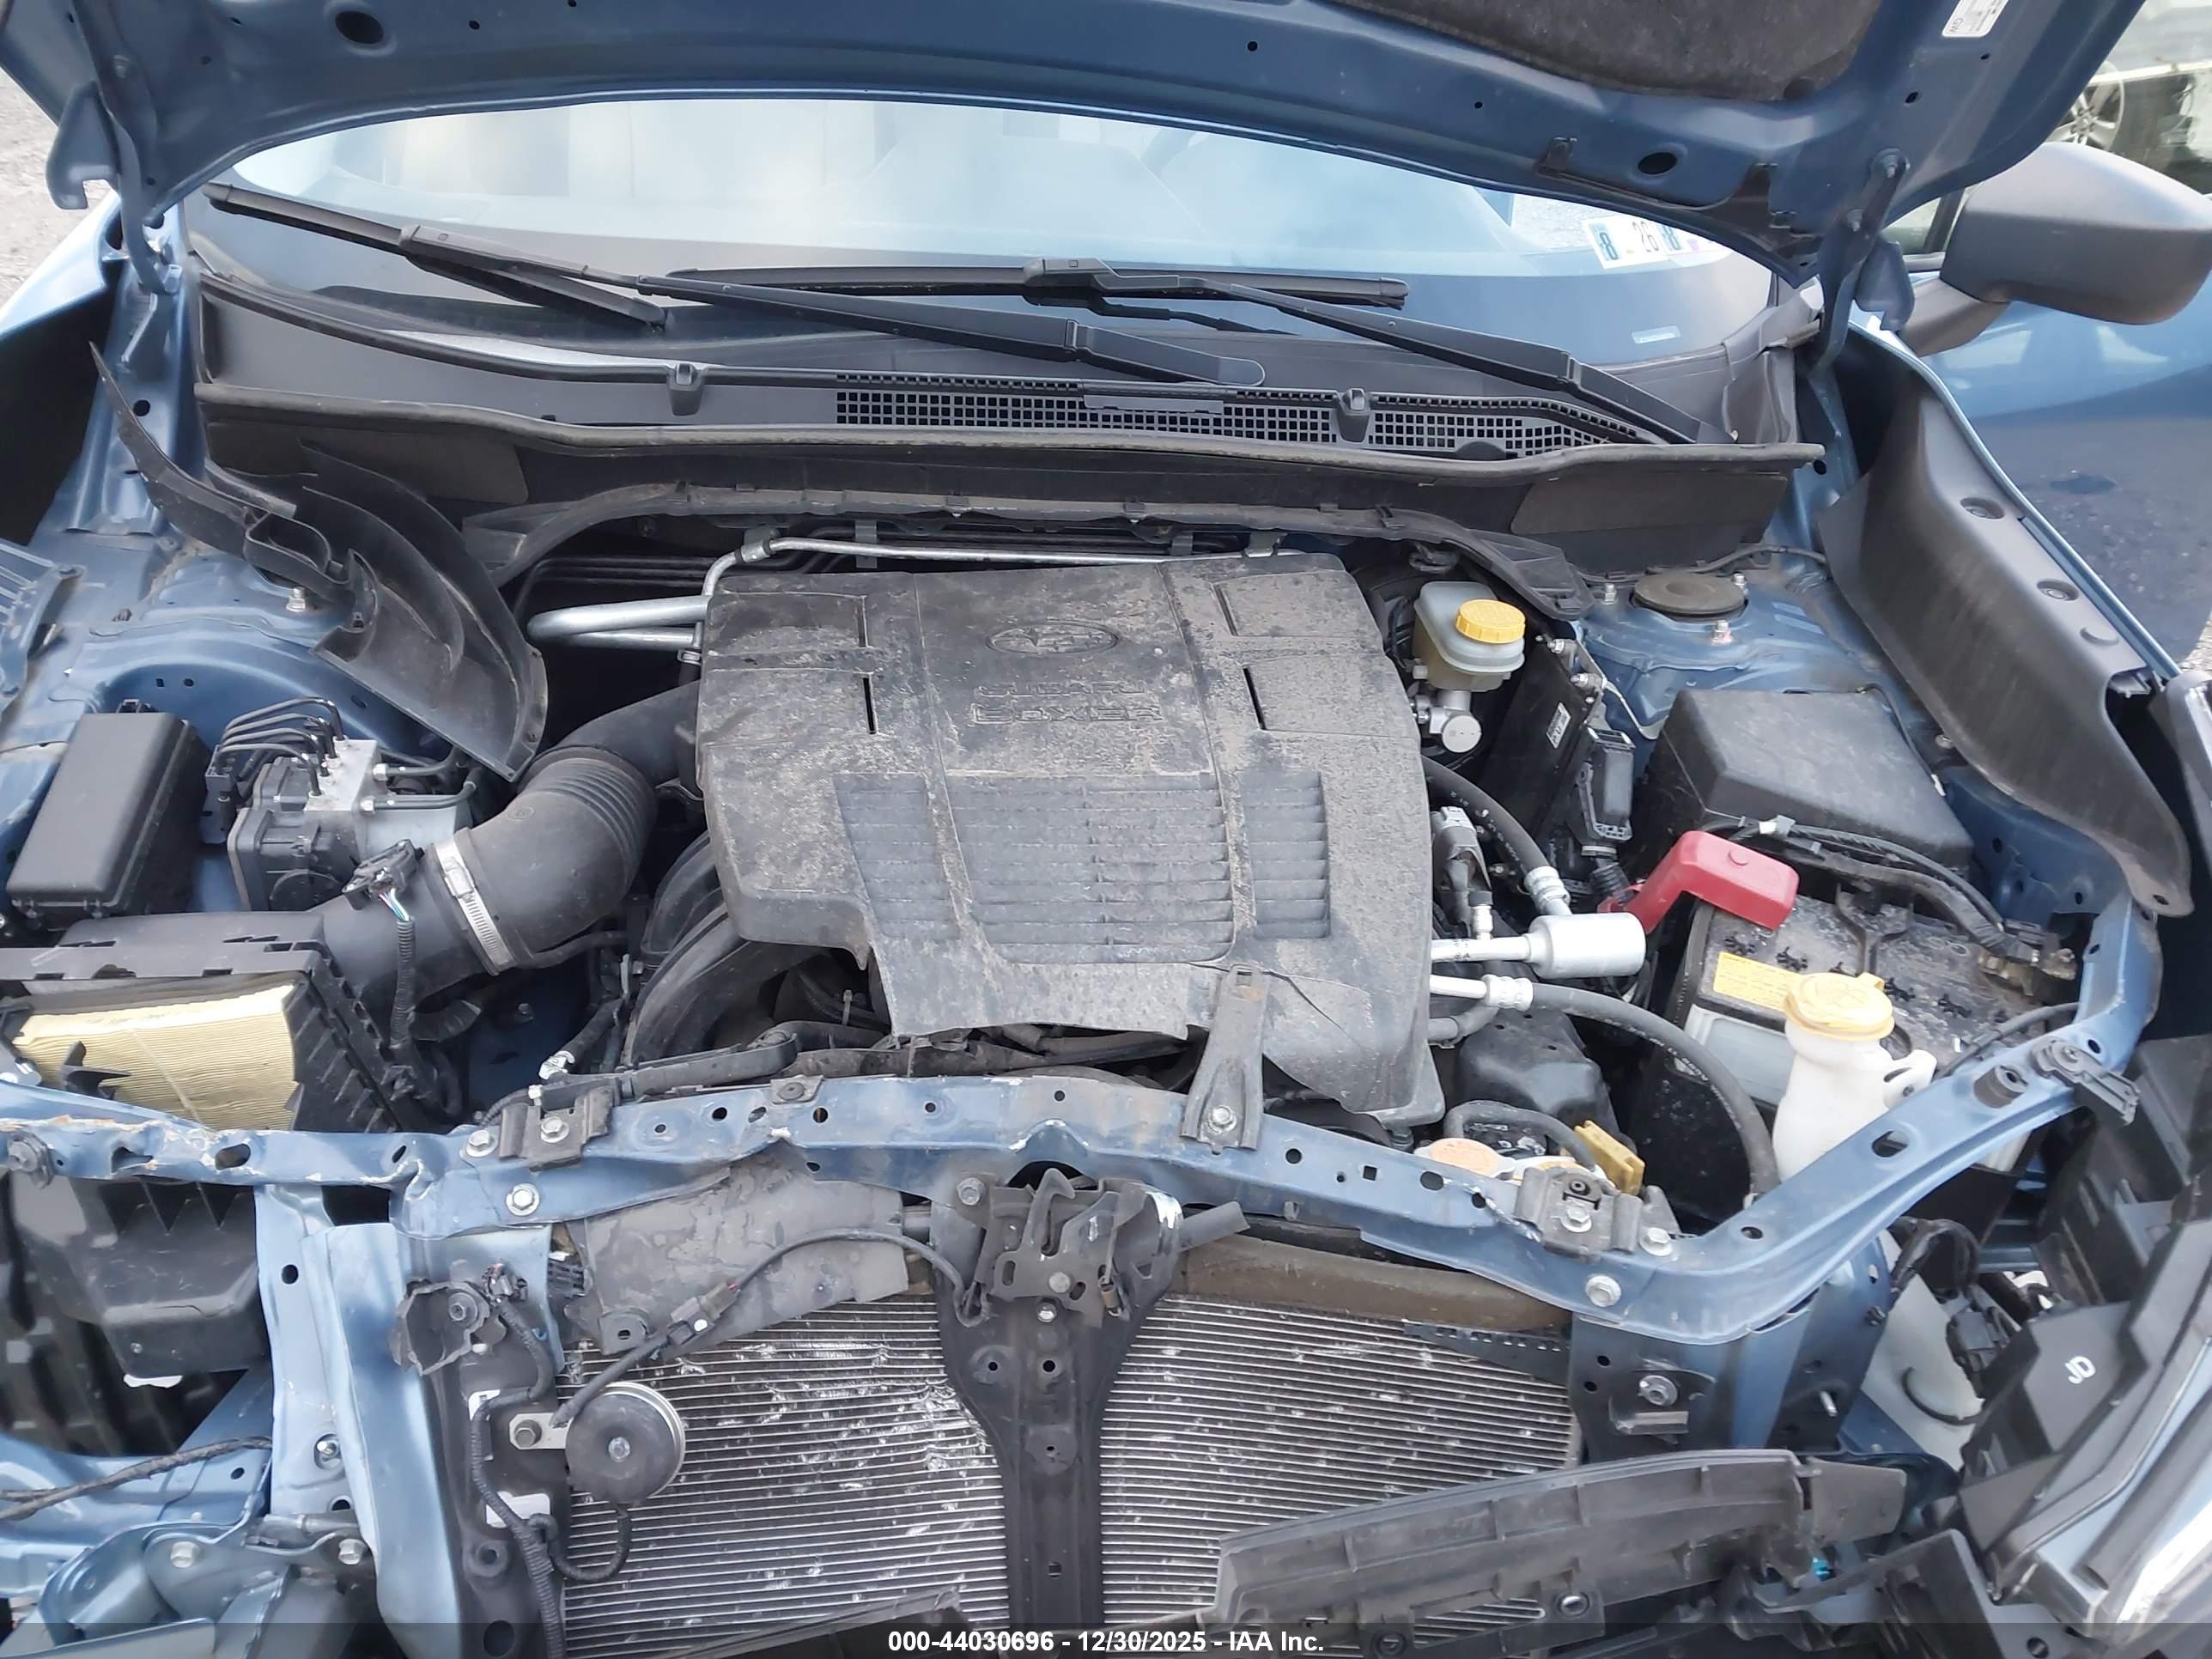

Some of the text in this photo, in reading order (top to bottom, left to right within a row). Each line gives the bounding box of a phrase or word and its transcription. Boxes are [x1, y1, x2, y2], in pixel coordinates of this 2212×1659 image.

[1599, 221, 1659, 260] 8 26
[2064, 1355, 2096, 1384] JD
